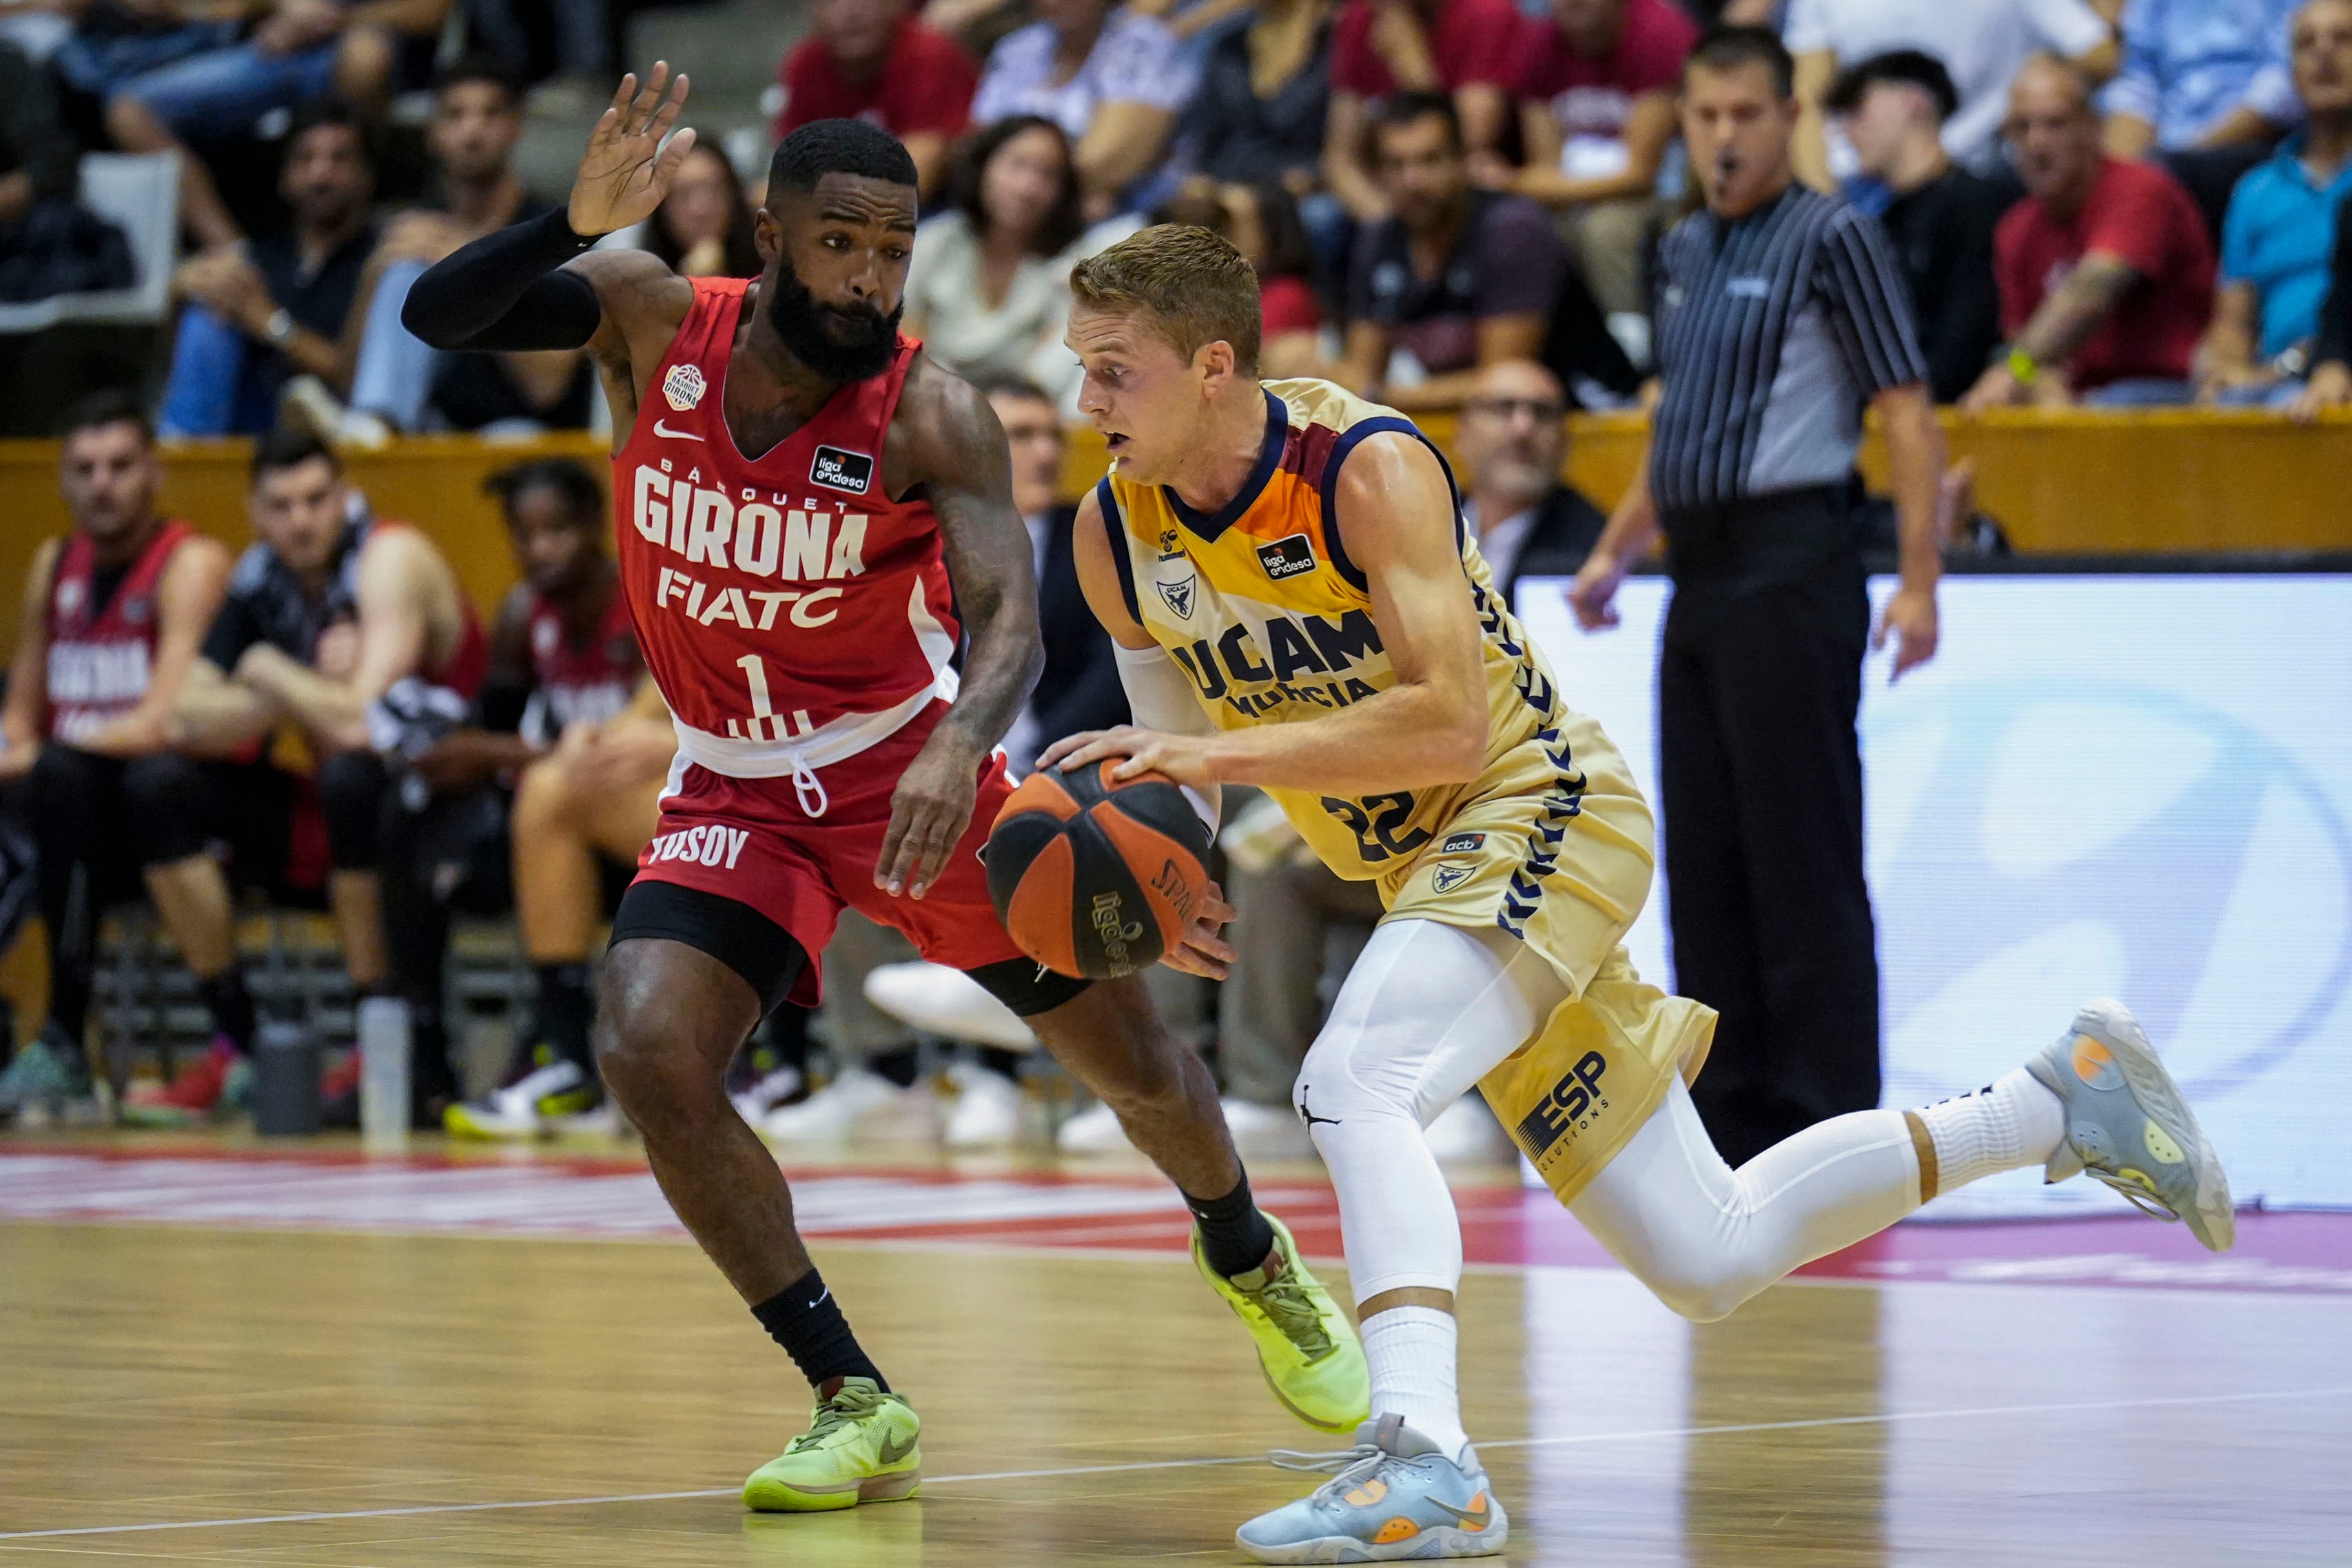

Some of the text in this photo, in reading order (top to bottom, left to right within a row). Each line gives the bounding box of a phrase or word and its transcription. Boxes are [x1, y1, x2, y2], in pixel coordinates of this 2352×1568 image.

[664, 382, 697, 408] GIRONA
[819, 457, 841, 473] liga
[816, 470, 865, 489] endesa
[634, 464, 868, 581] GIRONA
[1263, 555, 1285, 567] liga
[1270, 558, 1312, 576] endesa
[657, 566, 843, 631] FIATC
[1166, 585, 1187, 593] UCAM
[1172, 608, 1385, 700] UCAM
[1320, 790, 1432, 863] 22
[1445, 840, 1475, 852] acb
[1518, 1051, 1606, 1154] ESP
